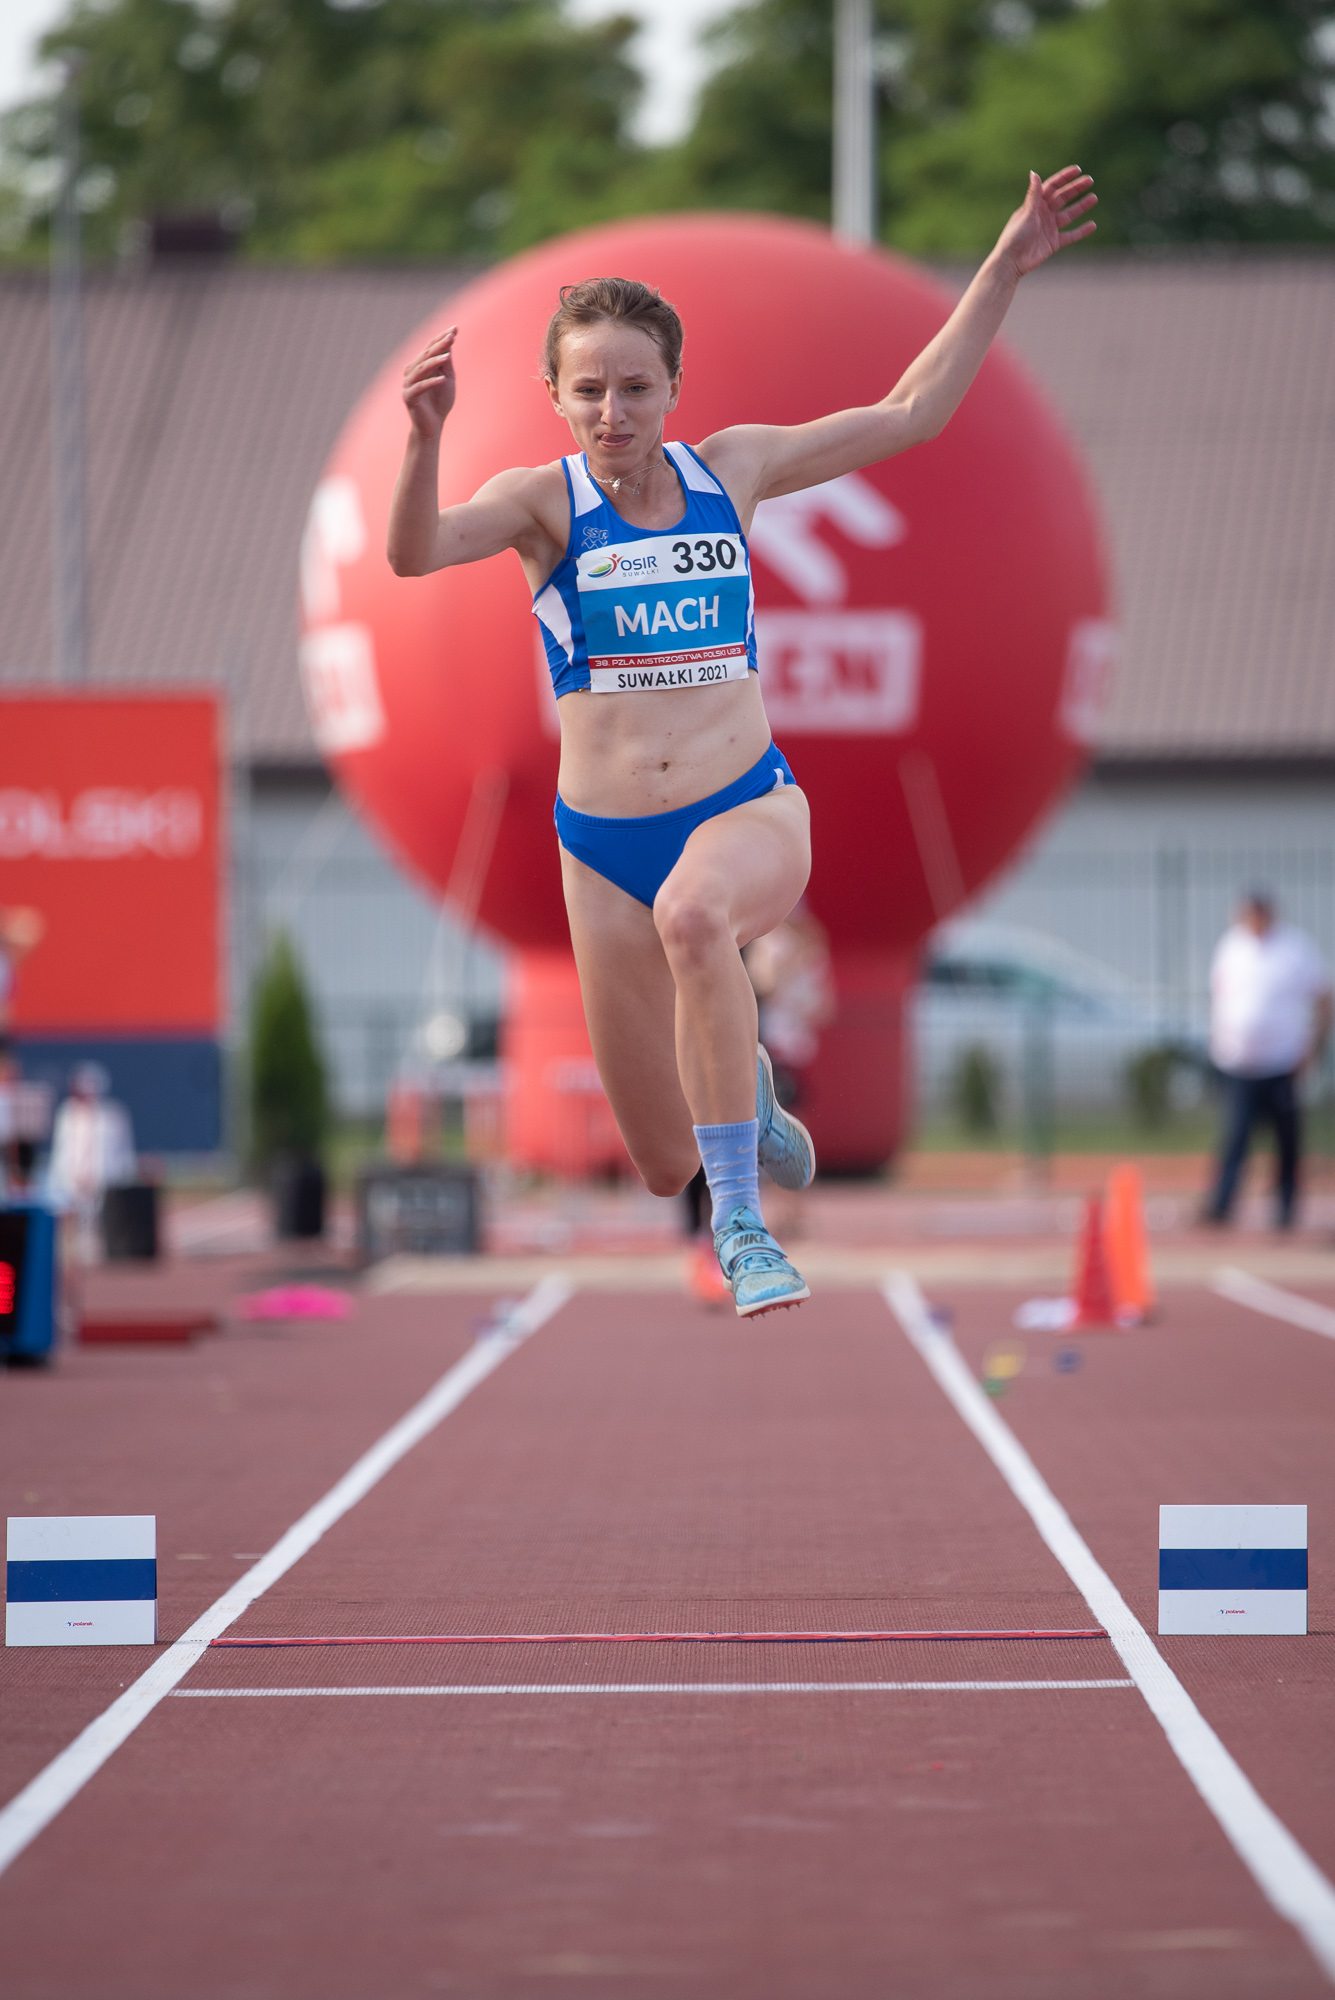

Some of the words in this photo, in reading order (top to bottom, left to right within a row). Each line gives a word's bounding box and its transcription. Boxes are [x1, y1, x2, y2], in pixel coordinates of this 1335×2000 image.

[620, 556, 658, 571] OSIR
[672, 539, 736, 574] 330
[622, 569, 660, 577] SUWAŁKI
[614, 595, 719, 637] MACH
[636, 653, 703, 665] MISTRZOSTWA
[703, 649, 726, 659] POLSKI
[727, 647, 742, 655] U23
[617, 668, 693, 688] SUWAŁKI
[698, 664, 728, 682] 2021
[733, 1233, 768, 1252] NIKE
